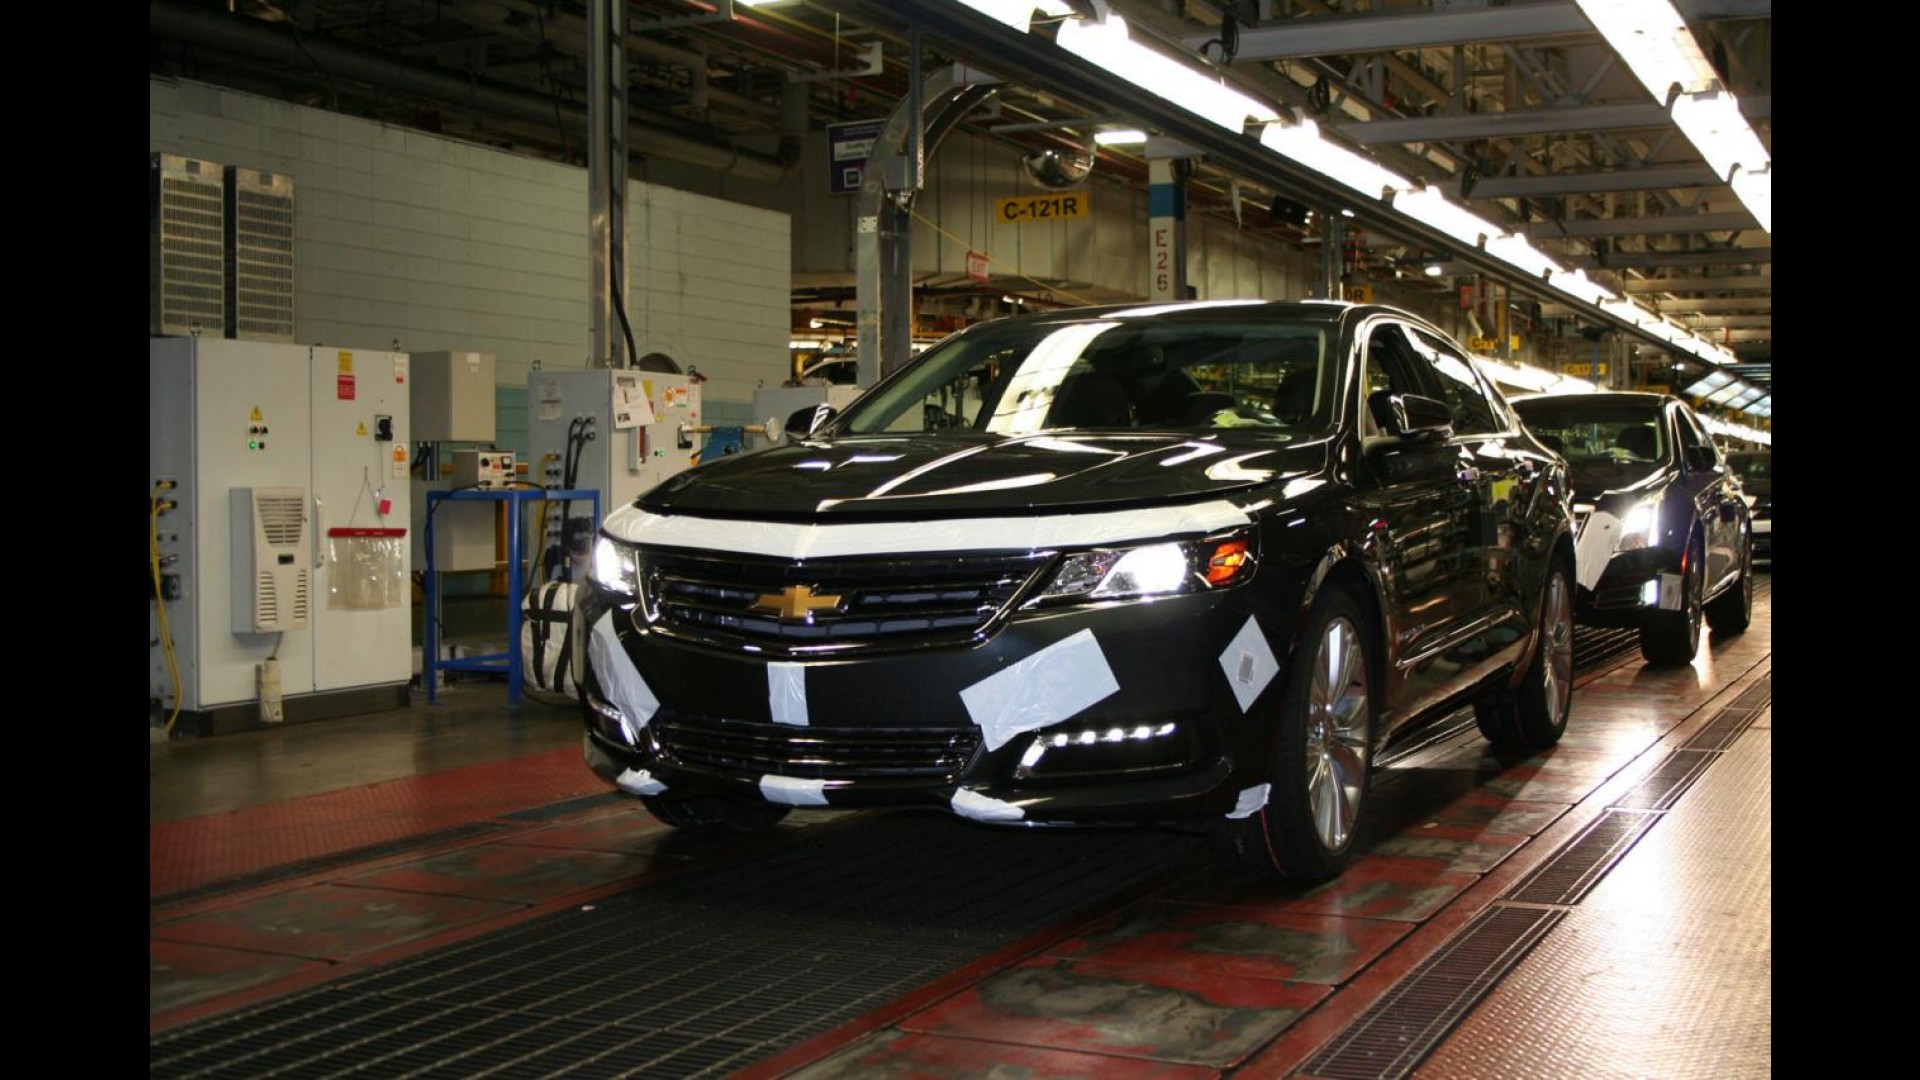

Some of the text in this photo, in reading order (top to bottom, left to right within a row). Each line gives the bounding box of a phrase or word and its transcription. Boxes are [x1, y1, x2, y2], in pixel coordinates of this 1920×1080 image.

[1003, 197, 1078, 220] C-121R
[971, 260, 987, 274] EXIT
[1155, 228, 1169, 292] E26
[1343, 287, 1365, 302] 0R
